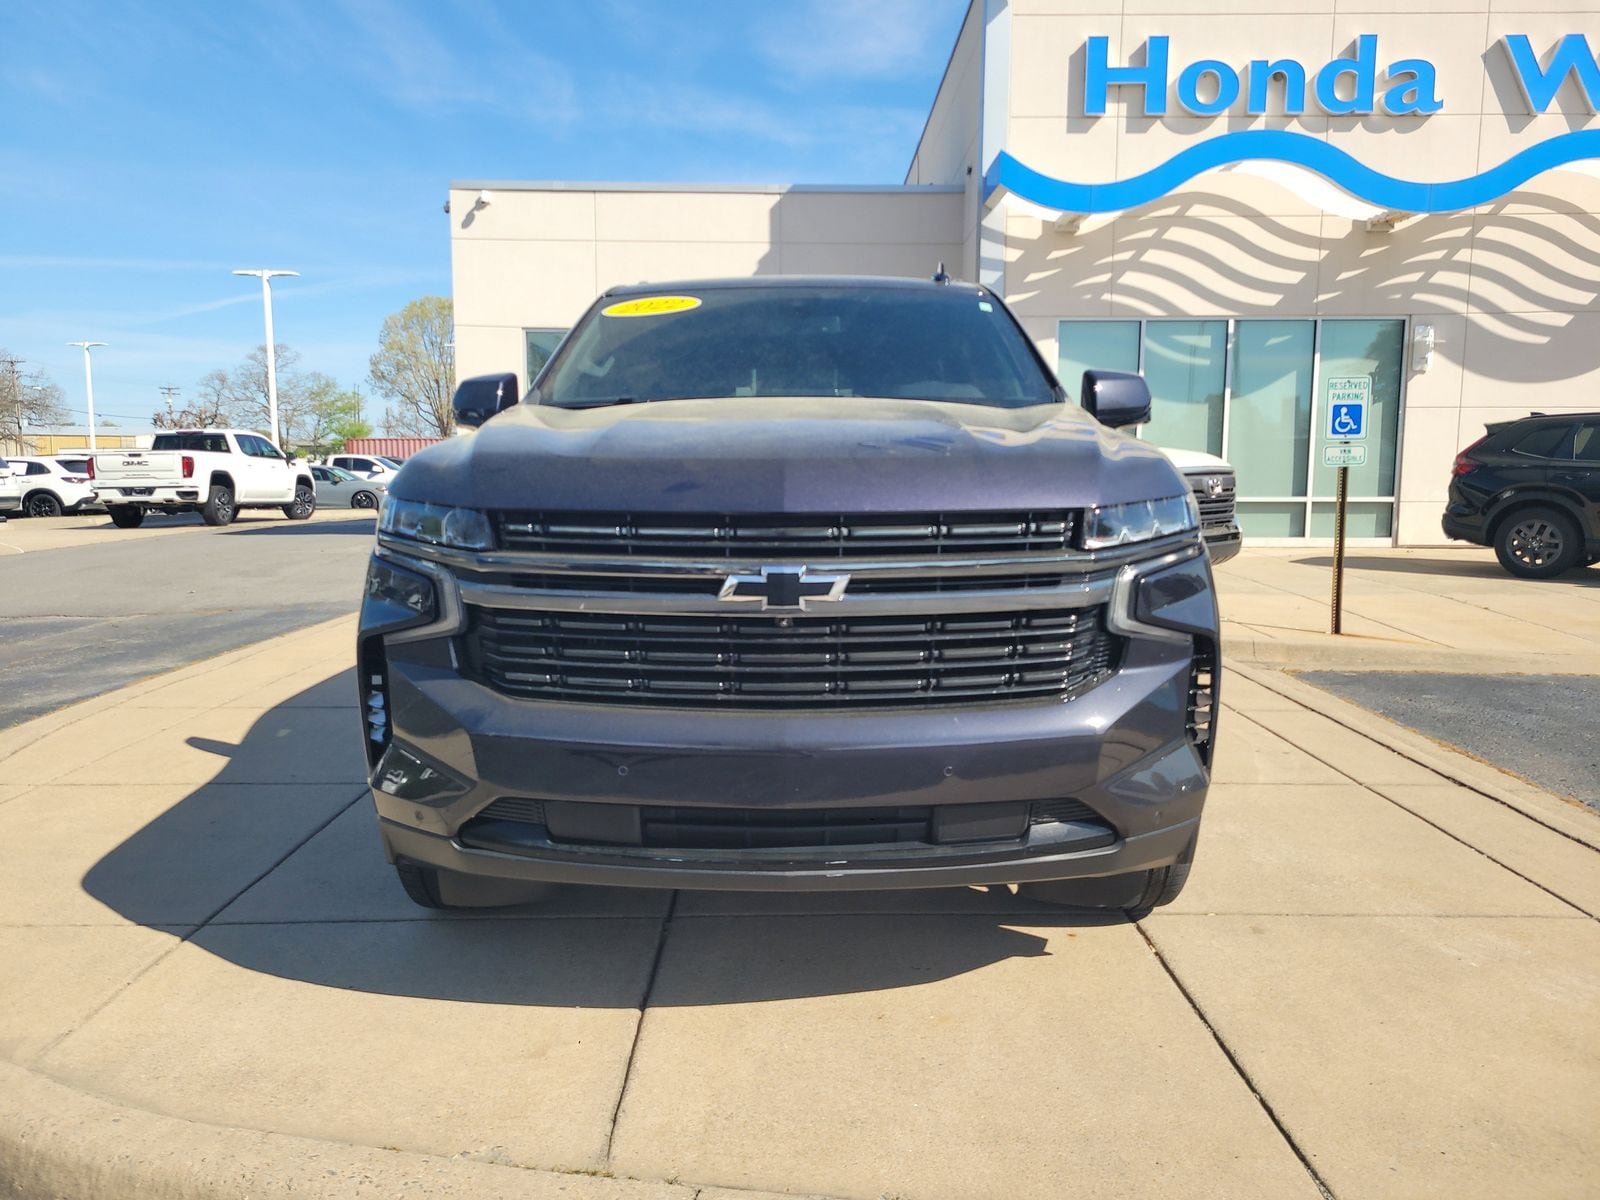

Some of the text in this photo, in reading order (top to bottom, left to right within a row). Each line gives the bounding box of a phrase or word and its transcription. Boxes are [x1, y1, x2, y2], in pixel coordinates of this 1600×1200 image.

[1083, 34, 1444, 117] Honda
[1328, 381, 1368, 390] RESERVED
[1331, 392, 1364, 401] PARKING
